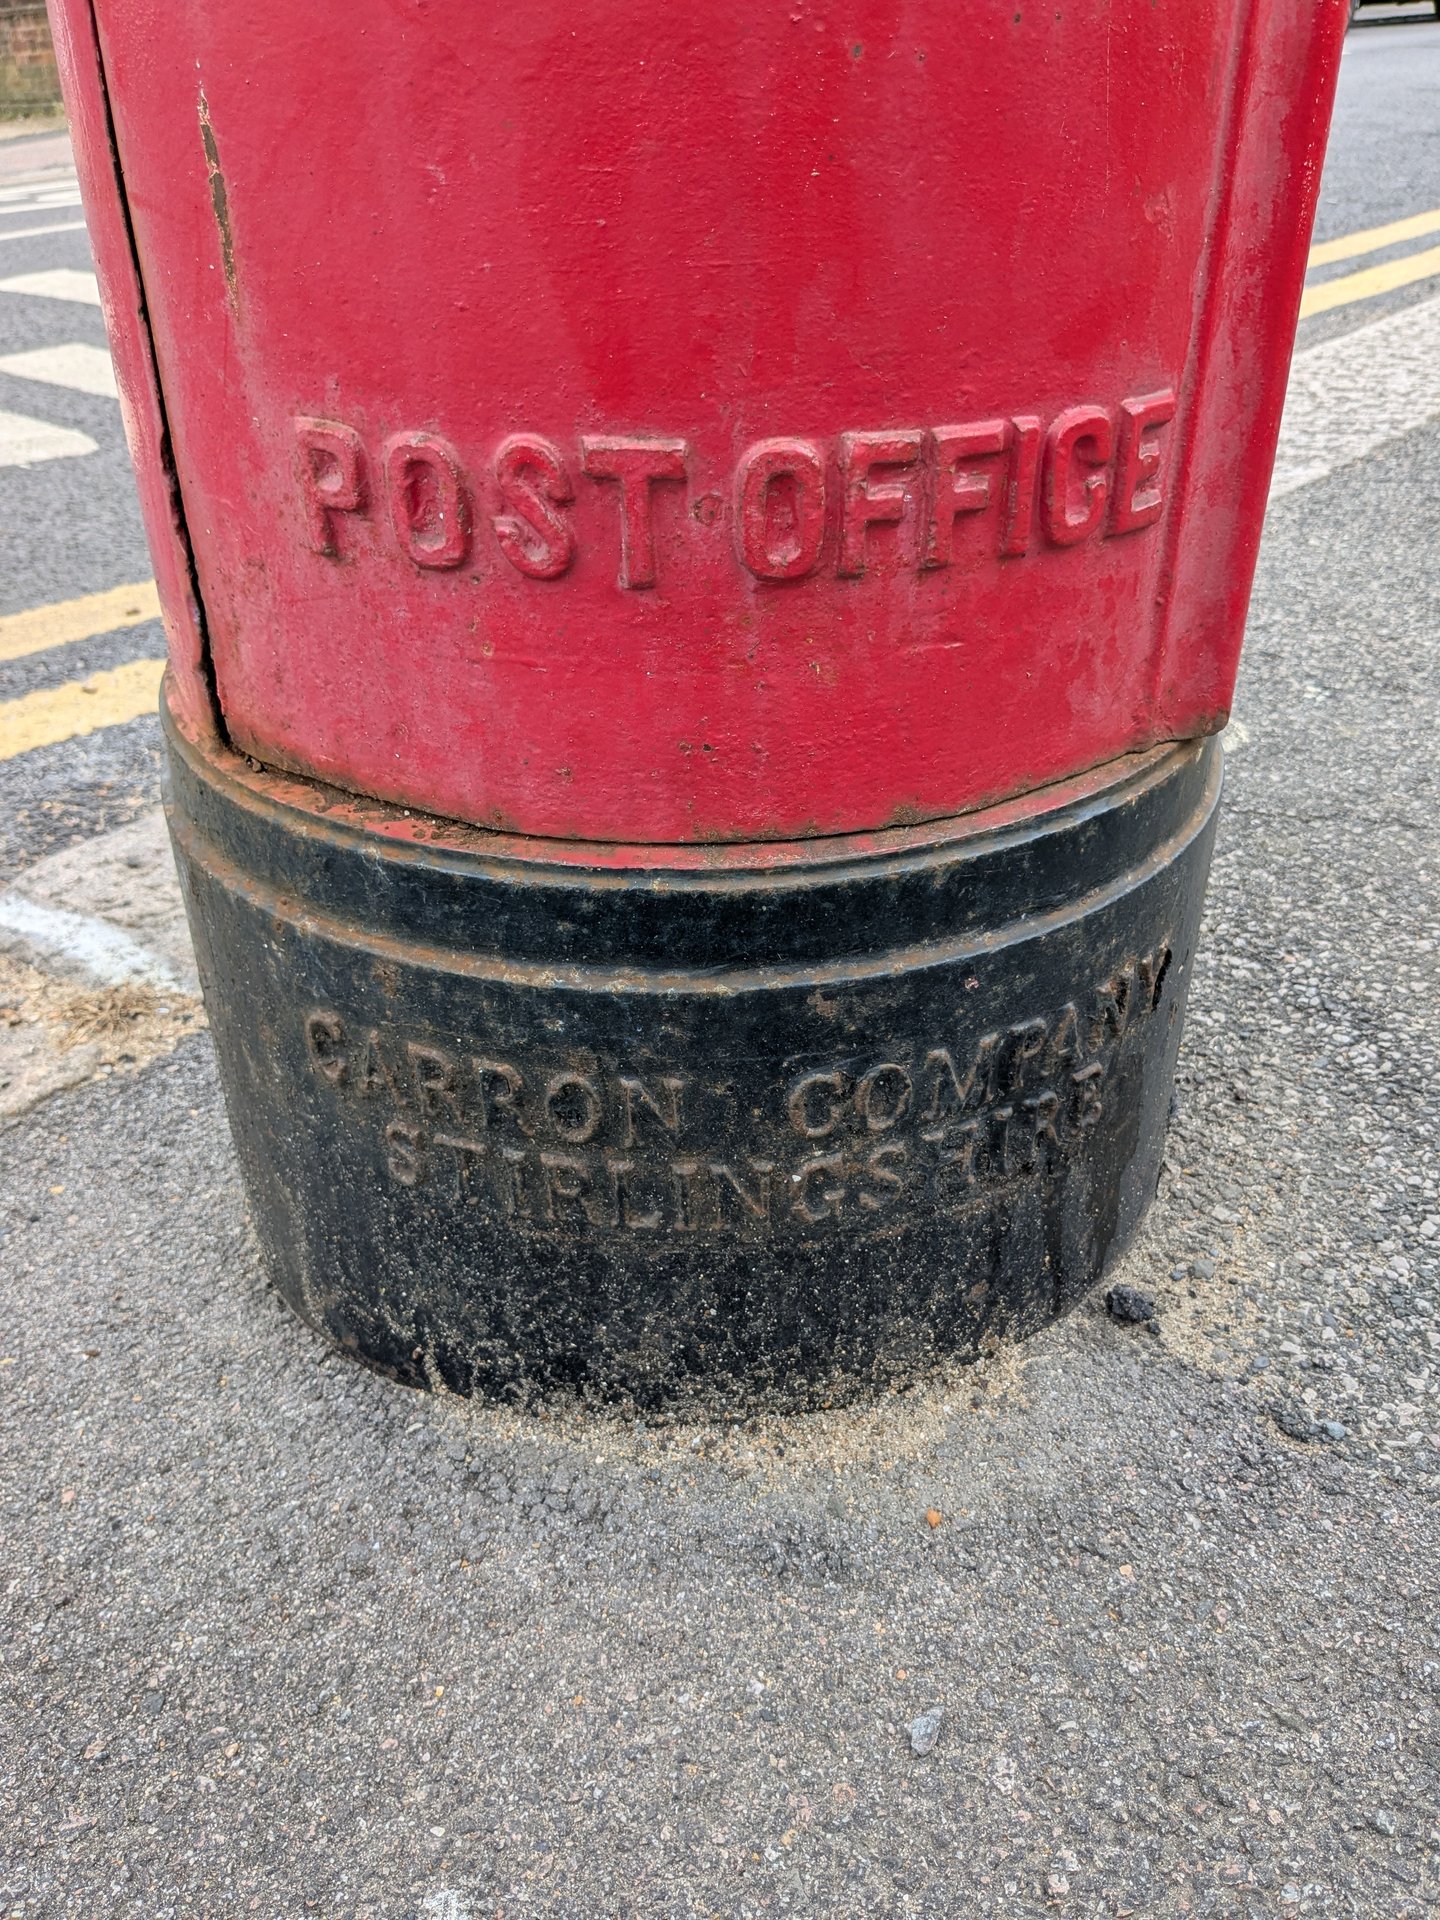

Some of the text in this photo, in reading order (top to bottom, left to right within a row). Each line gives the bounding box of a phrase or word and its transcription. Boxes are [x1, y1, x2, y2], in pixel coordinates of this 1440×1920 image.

[294, 389, 1176, 592] POST OFFICE
[303, 1008, 688, 1150] CARRON
